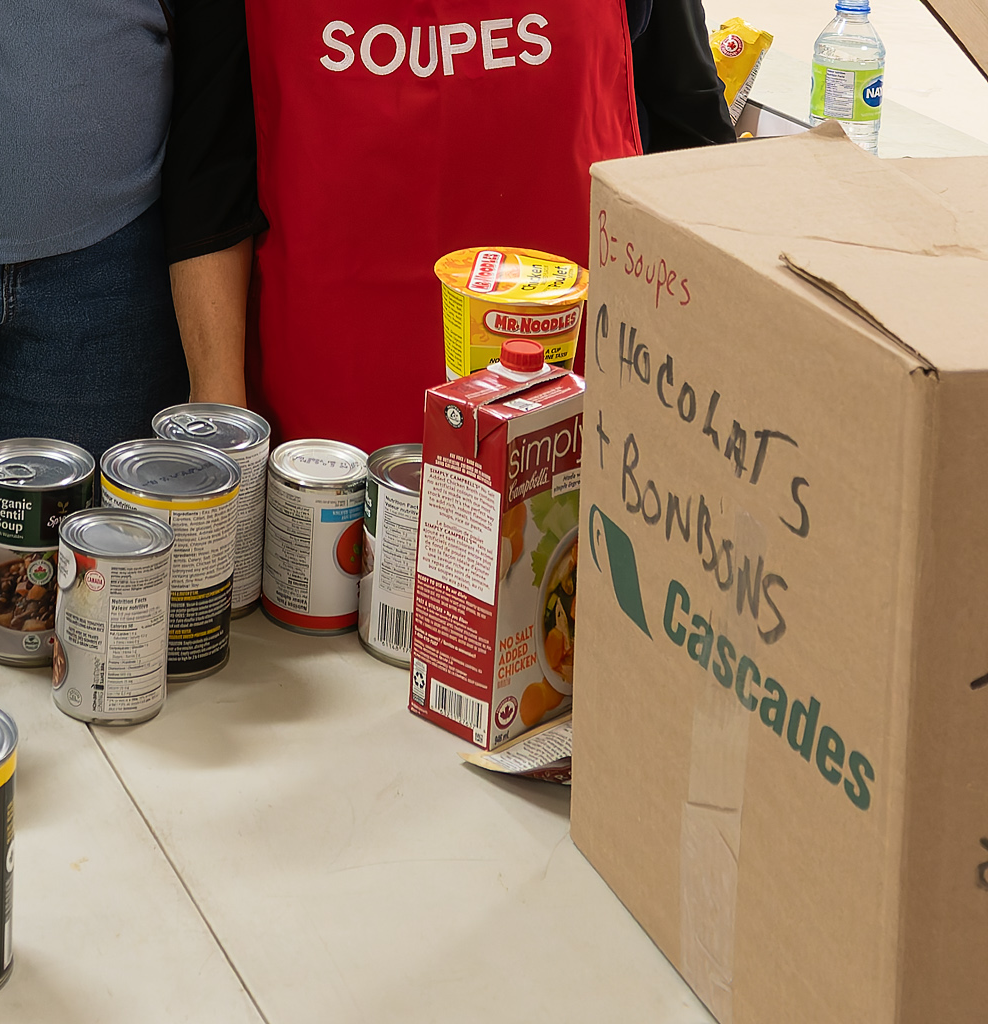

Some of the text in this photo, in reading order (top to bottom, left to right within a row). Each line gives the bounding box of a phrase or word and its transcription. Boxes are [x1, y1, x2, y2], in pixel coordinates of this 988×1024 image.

[319, 13, 552, 78] SOUPES
[430, 468, 448, 478] SIMPLY
[425, 522, 443, 532] SIMPLY
[620, 433, 788, 645] BONBONS
[499, 624, 534, 652] NO SALT
[498, 642, 528, 666] ADDED
[498, 651, 538, 679] CHICKEN
[662, 580, 876, 812] Cascades
